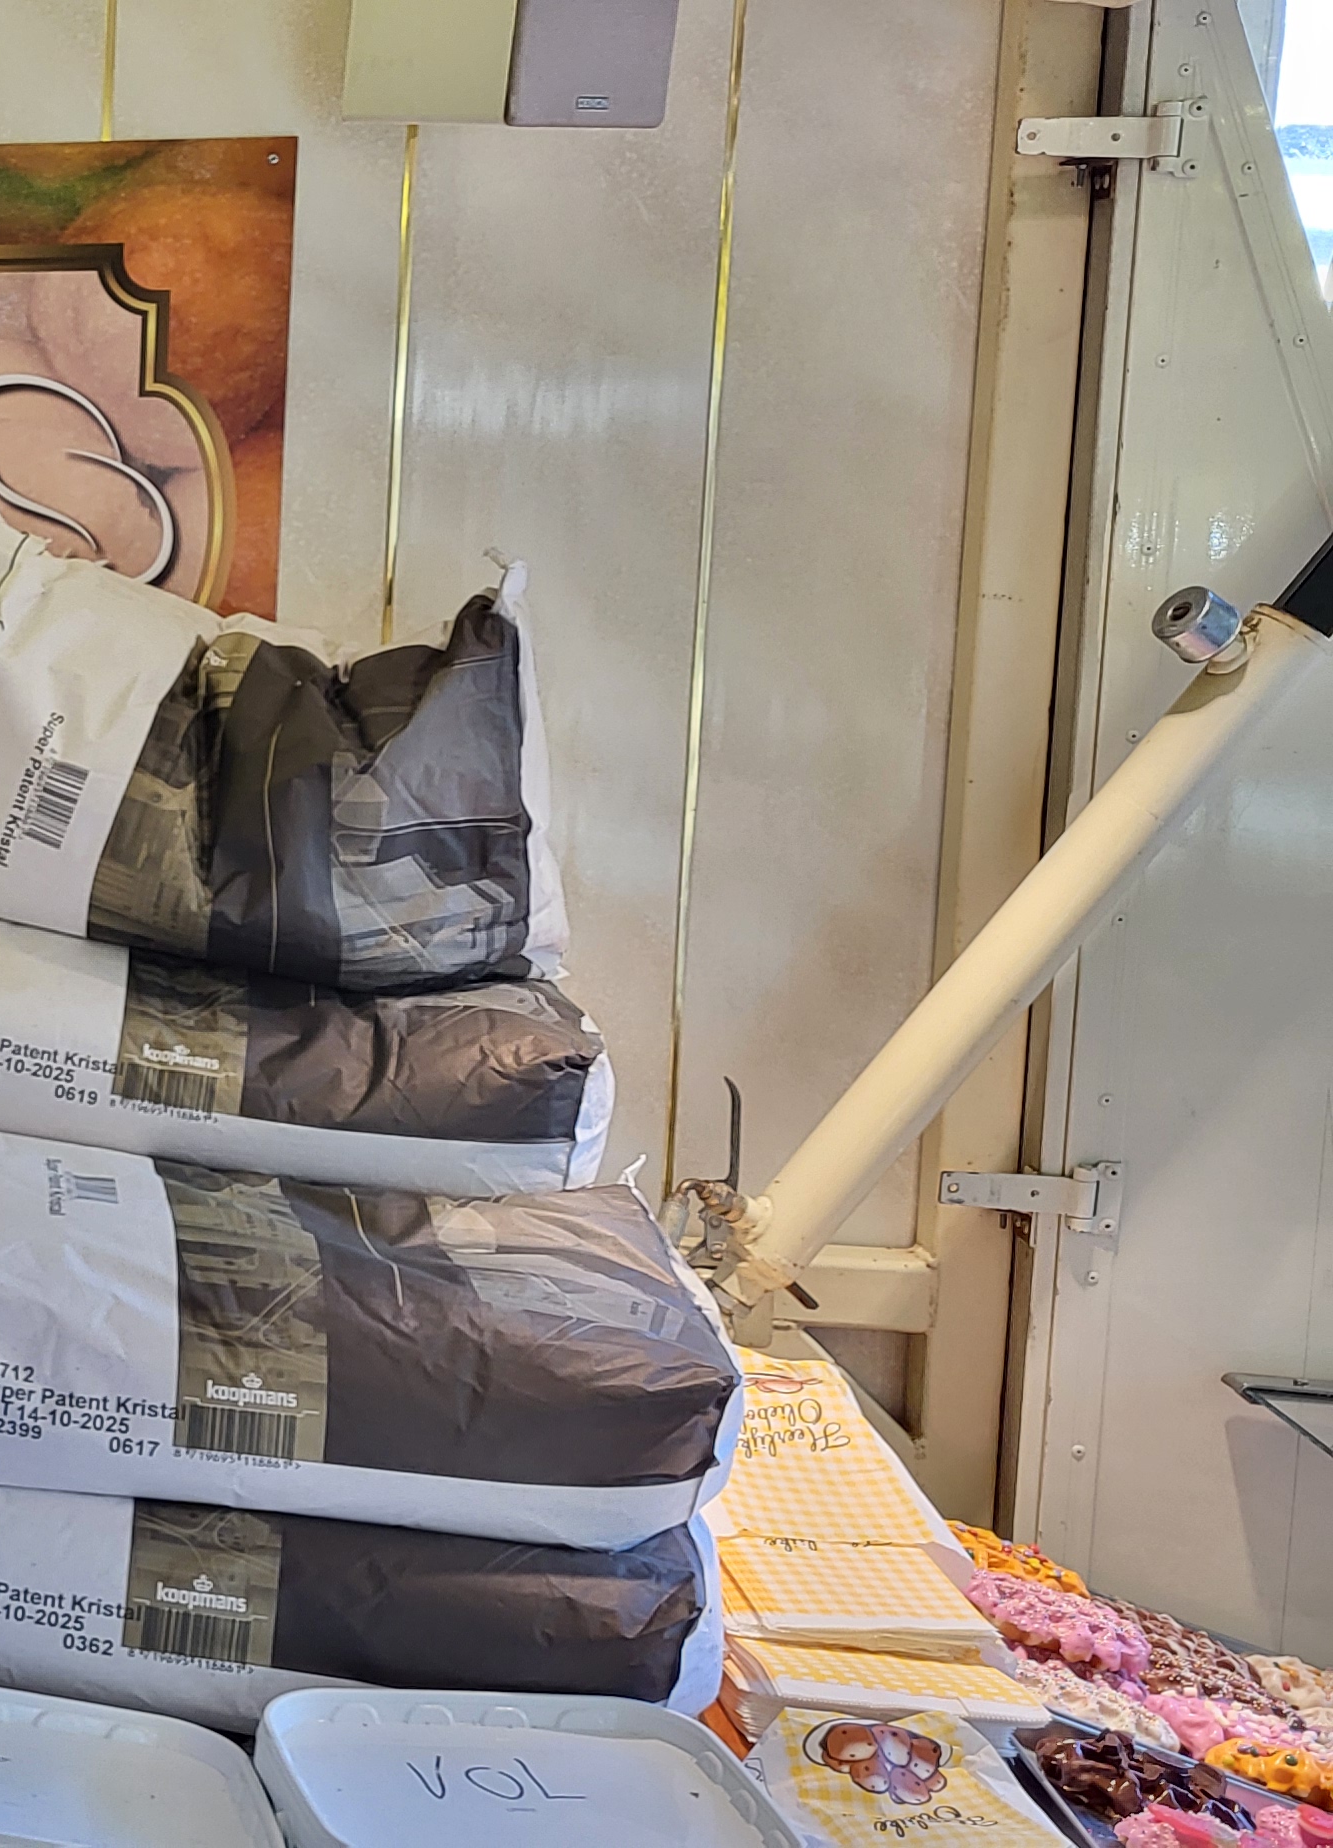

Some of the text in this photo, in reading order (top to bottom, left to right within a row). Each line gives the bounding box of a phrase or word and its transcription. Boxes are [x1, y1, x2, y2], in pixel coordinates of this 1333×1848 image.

[34, 711, 65, 755] Super
[14, 756, 42, 815] Patent
[0, 1038, 59, 1065] Patent
[64, 1050, 124, 1076] Kristal
[142, 1043, 220, 1071] koopmans
[53, 1083, 98, 1106] 0619
[40, 1388, 109, 1413] Patent
[115, 1398, 185, 1422] Kristal
[205, 1379, 299, 1408] koopmans
[18, 1404, 131, 1435] 14-10-2025
[108, 1436, 161, 1458] 0617
[71, 1595, 142, 1622] Kristal
[155, 1581, 248, 1612] koopmans
[62, 1632, 114, 1656] 0362
[406, 1754, 587, 1801] VOL
